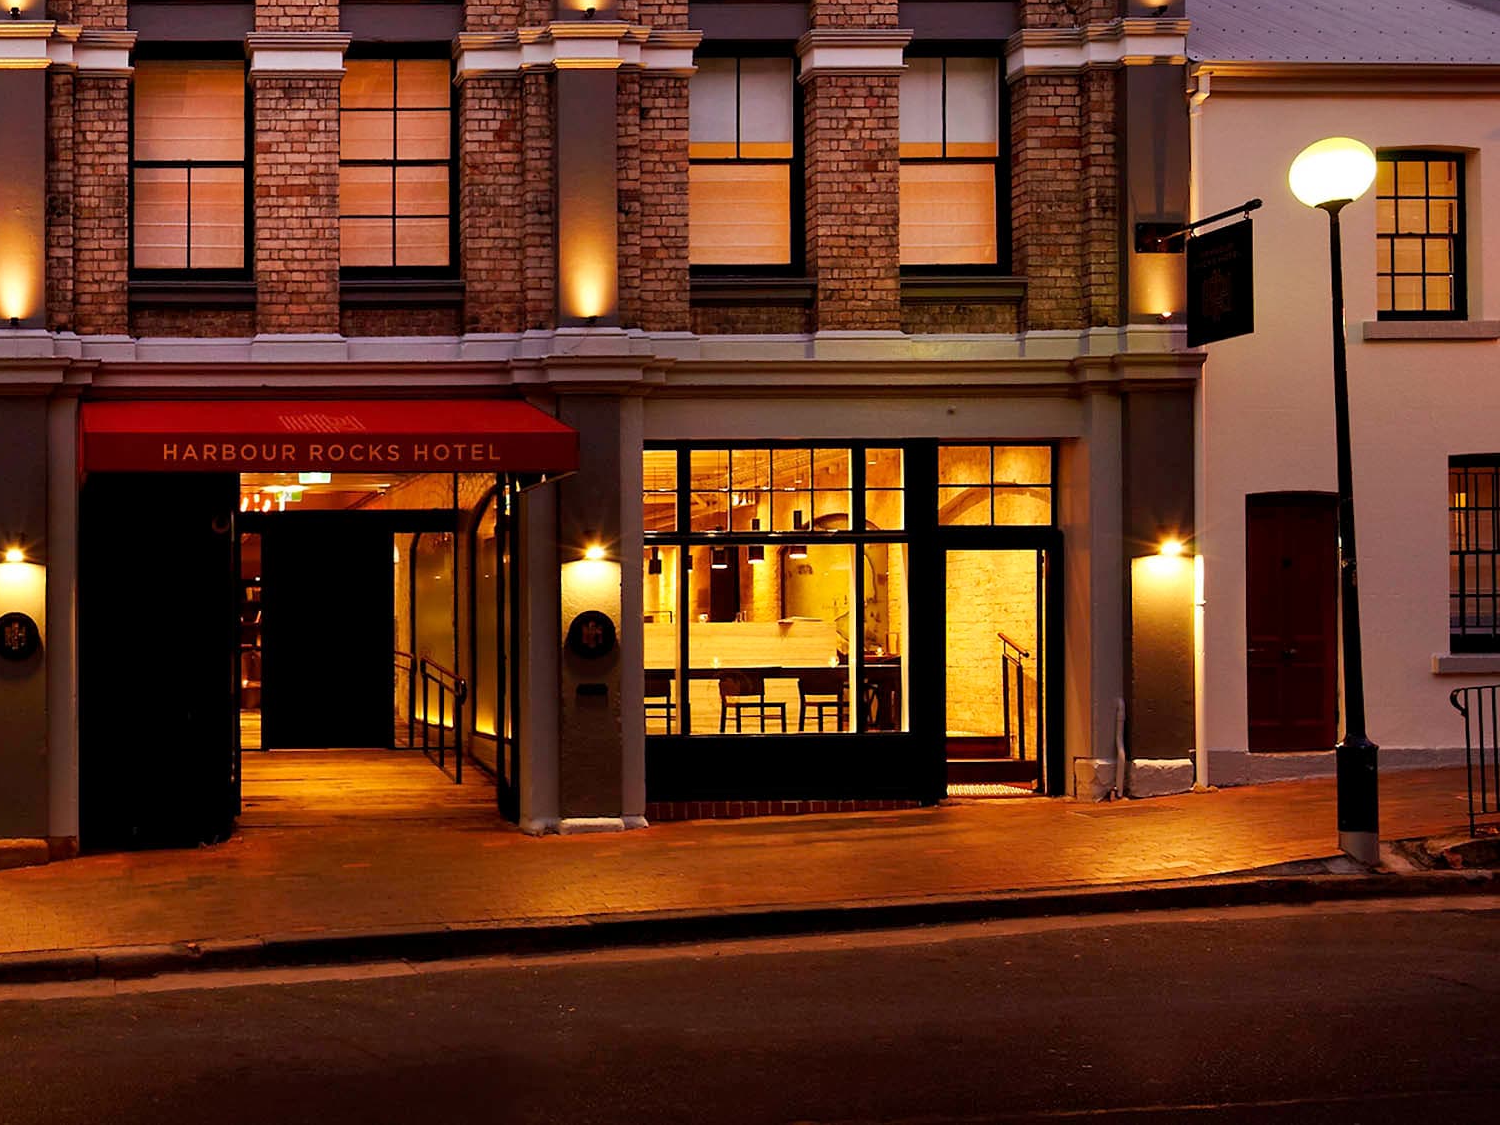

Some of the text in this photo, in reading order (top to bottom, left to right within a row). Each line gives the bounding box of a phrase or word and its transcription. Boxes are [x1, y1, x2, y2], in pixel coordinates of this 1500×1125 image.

[163, 443, 500, 462] HARBOUR ROCKS HOTEL
